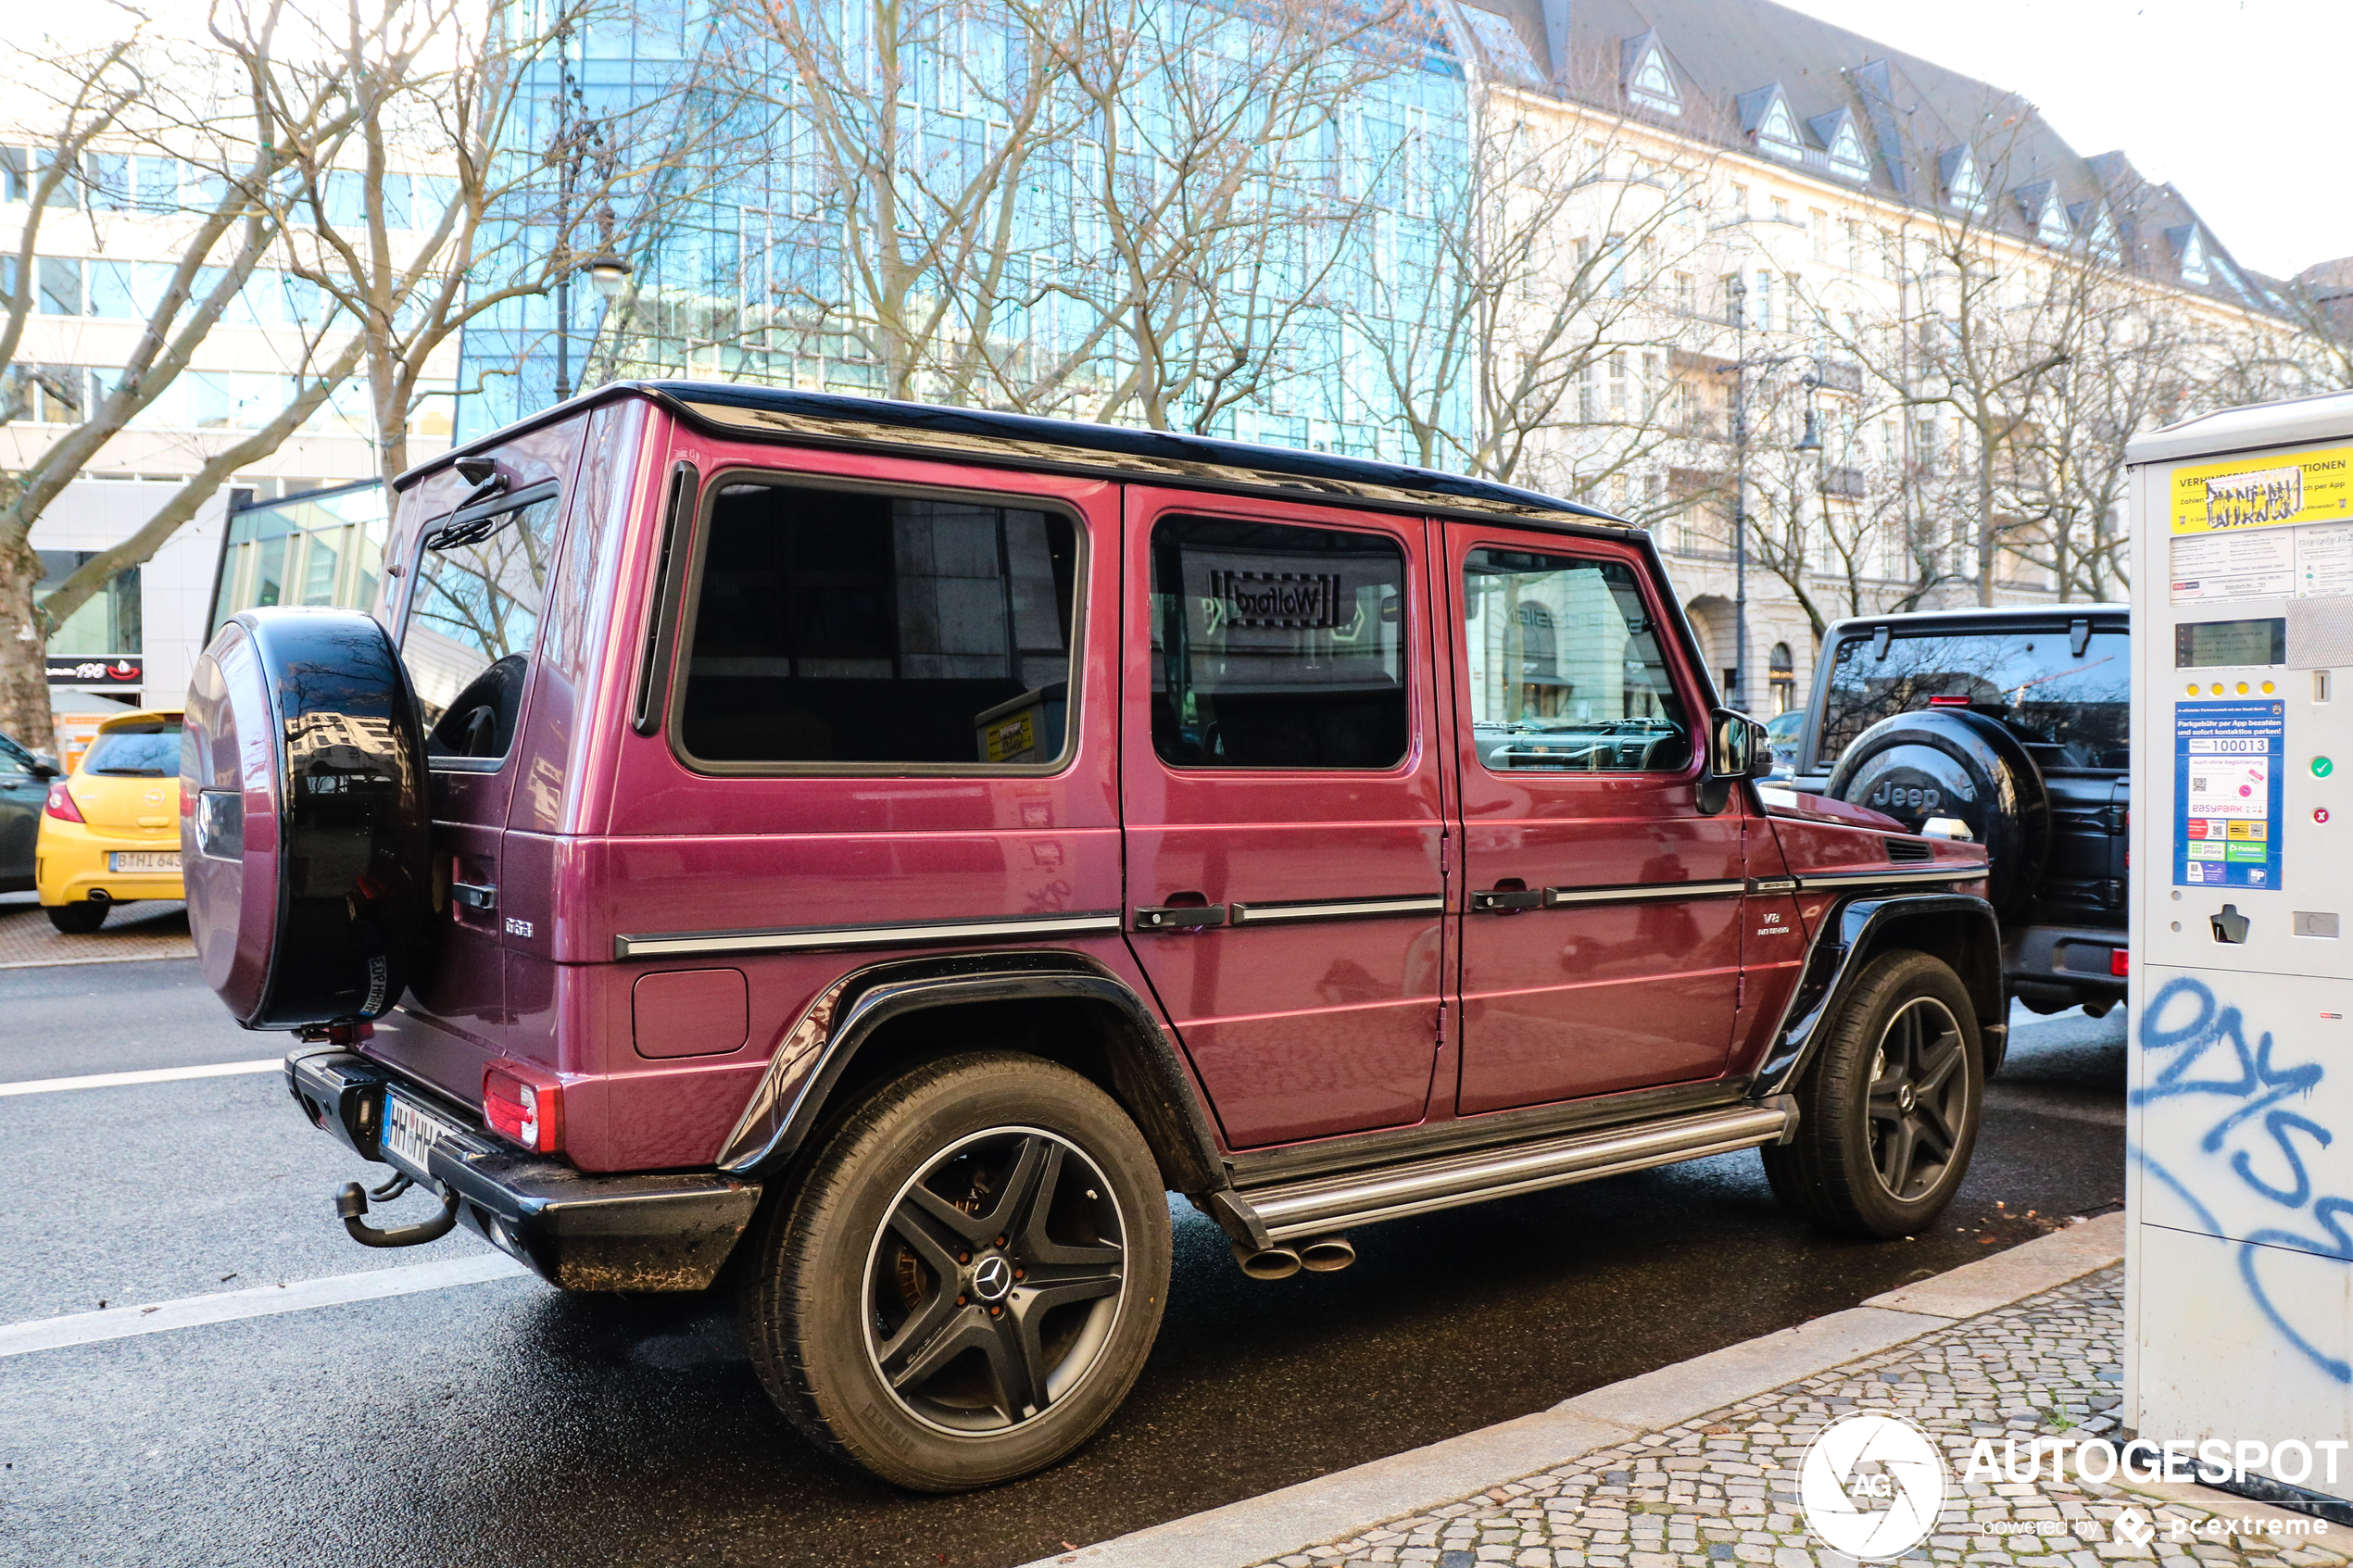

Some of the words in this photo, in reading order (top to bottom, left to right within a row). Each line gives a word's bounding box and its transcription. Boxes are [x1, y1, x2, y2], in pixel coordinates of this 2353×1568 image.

[2180, 496, 2204, 505] Zahlen
[2314, 483, 2328, 492] per
[2329, 481, 2346, 490] App
[76, 662, 106, 679] 195
[2213, 740, 2265, 751] 100013
[1874, 781, 1940, 813] Jeep
[118, 855, 126, 867] B
[136, 855, 153, 867] HI
[1764, 913, 1780, 924] V8
[390, 1104, 408, 1151] HH
